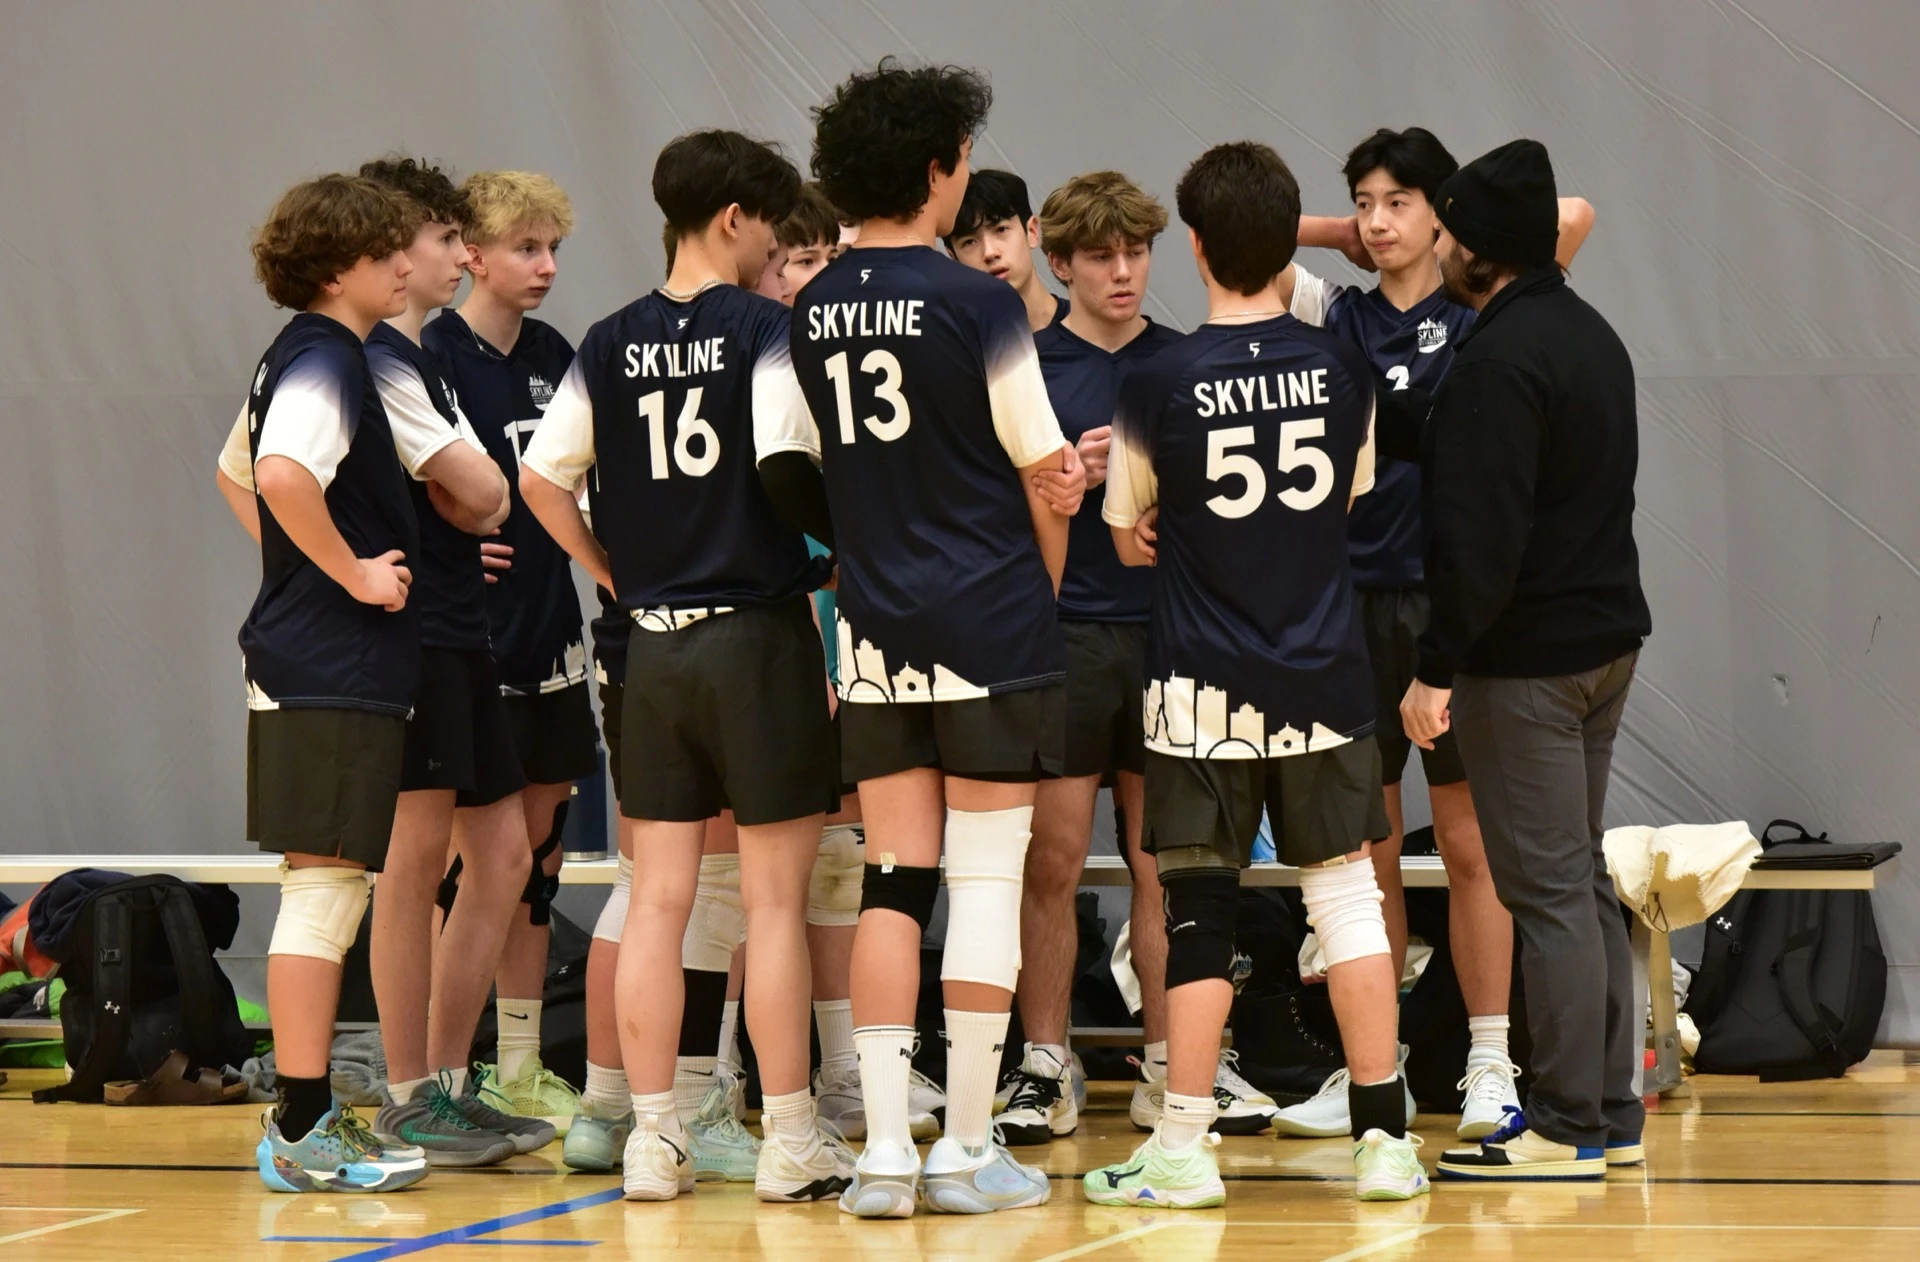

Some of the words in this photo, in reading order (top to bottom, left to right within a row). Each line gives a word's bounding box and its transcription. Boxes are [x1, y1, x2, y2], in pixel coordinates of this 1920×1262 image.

[808, 300, 924, 341] SKYLINE
[625, 337, 725, 378] SKYLINE
[1194, 368, 1330, 418] SKYLINE
[824, 349, 911, 445] 13
[638, 387, 721, 480] 16
[1205, 417, 1335, 519] 55
